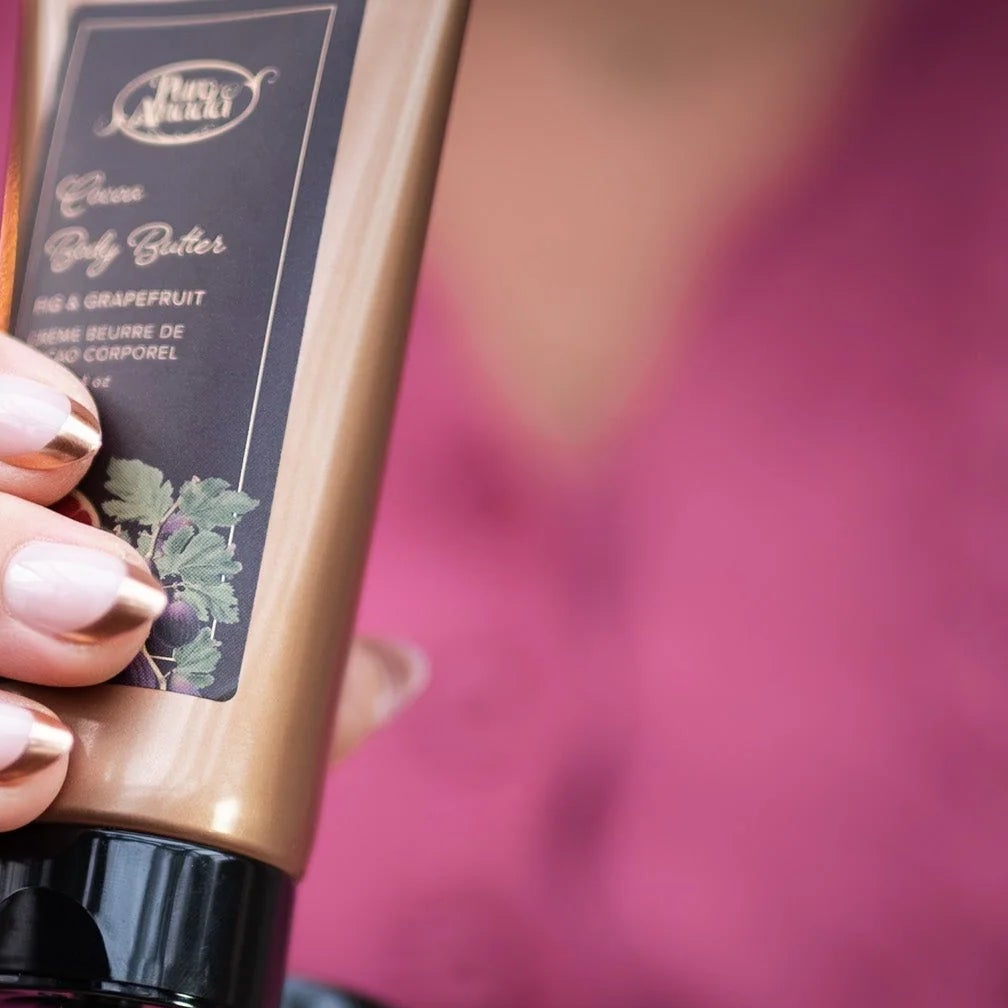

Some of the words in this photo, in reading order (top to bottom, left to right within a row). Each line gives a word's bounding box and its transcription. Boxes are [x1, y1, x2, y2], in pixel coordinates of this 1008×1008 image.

[44, 226, 122, 278] Body
[127, 221, 227, 267] Butter
[32, 294, 64, 316] FIG
[83, 289, 207, 311] GRAPEFRUIT
[85, 323, 156, 342] BEURRE
[159, 323, 186, 340] DE
[83, 345, 179, 364] CORPOREL
